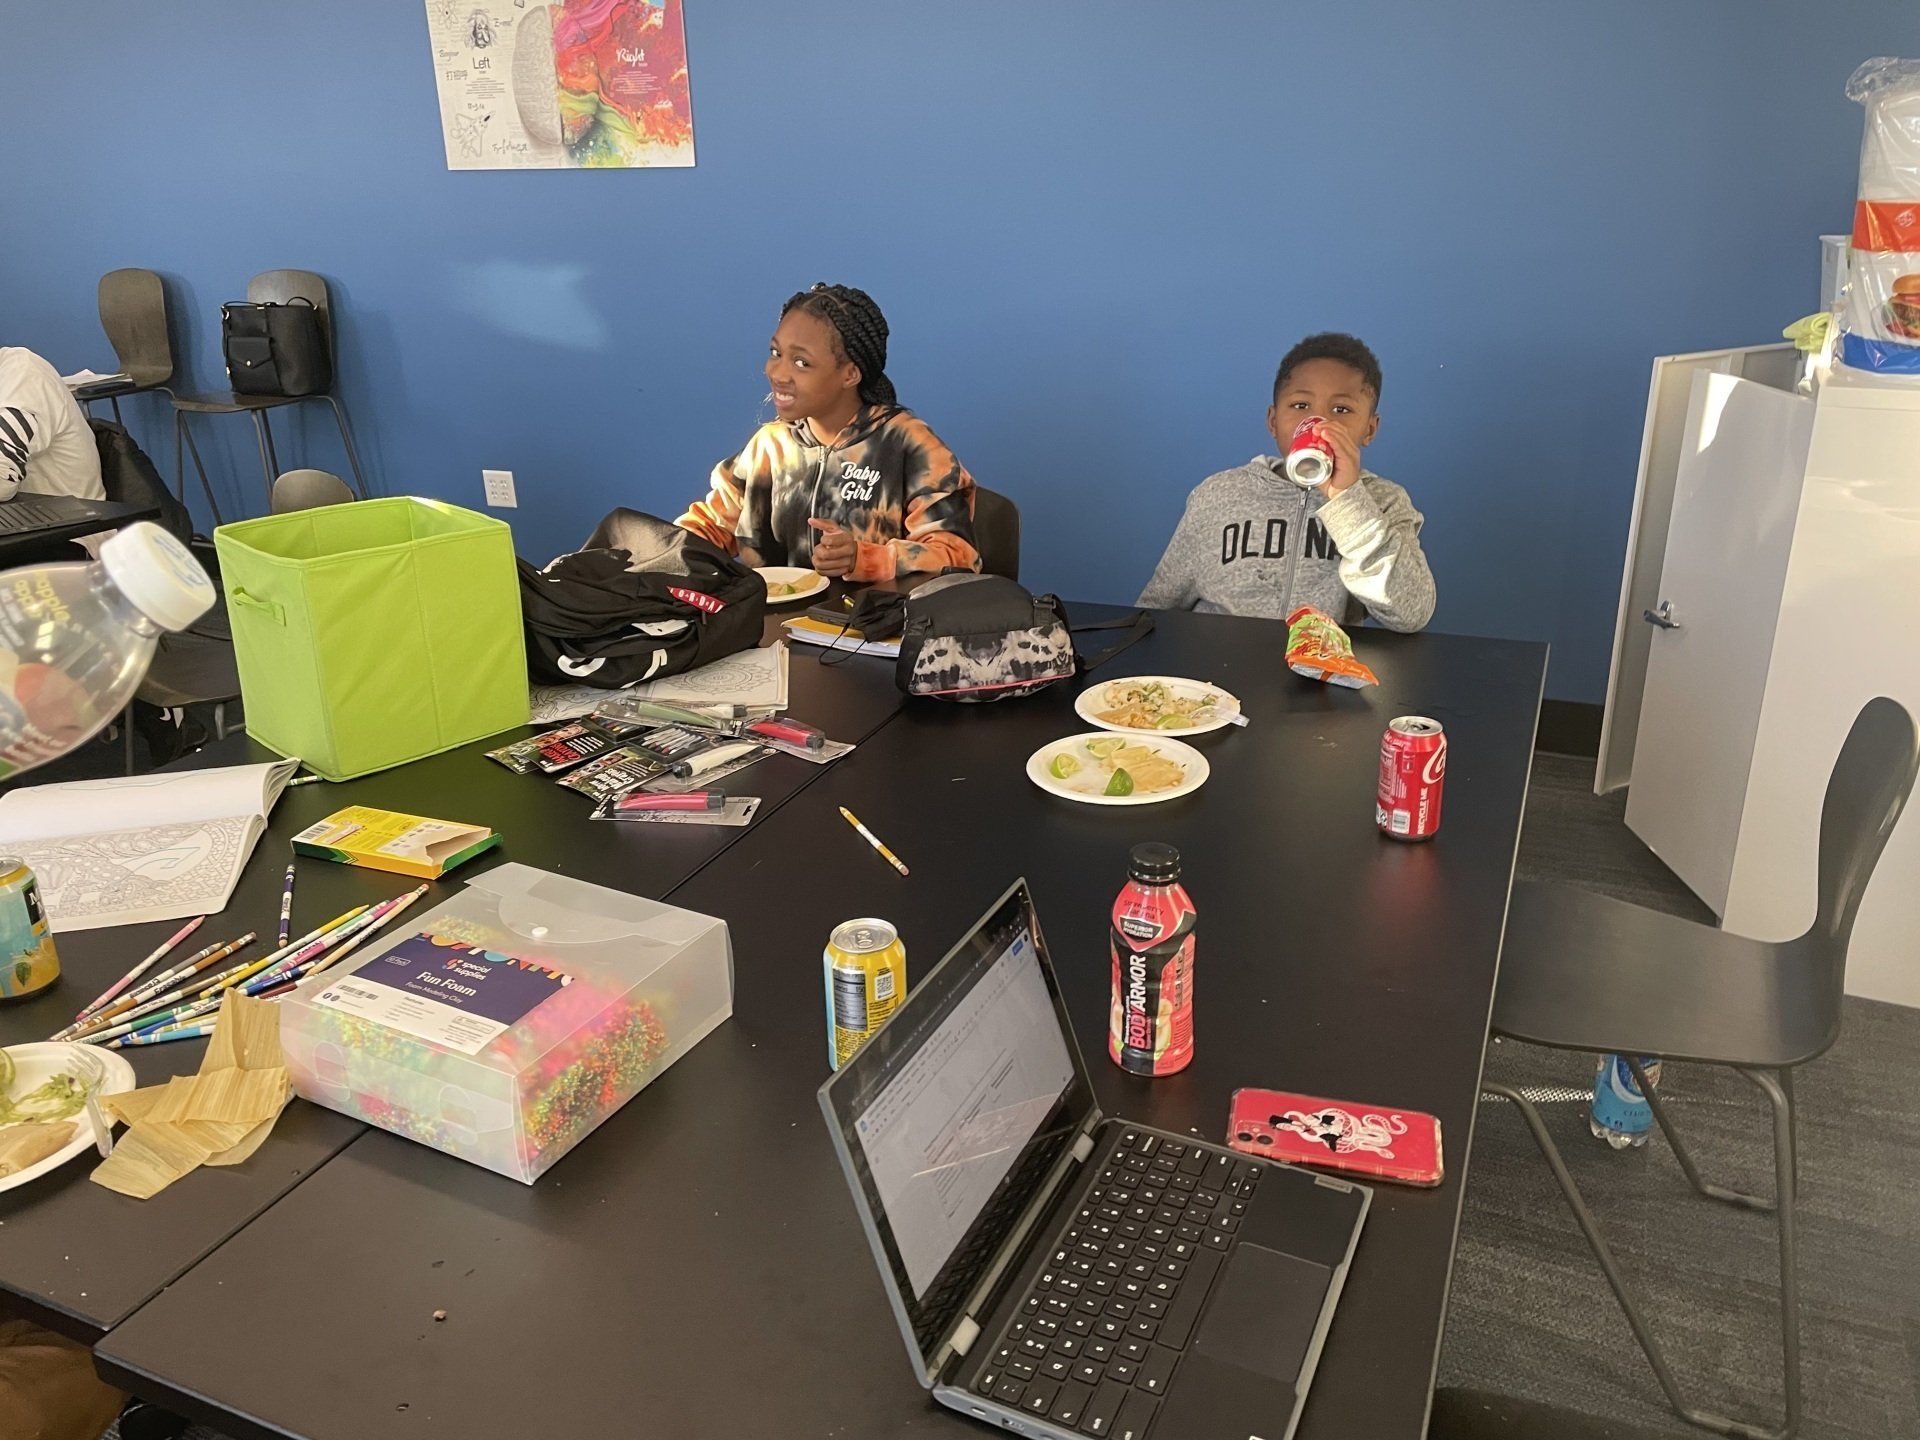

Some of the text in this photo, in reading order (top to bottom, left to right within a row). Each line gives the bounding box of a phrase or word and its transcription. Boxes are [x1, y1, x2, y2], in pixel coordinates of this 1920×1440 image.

[473, 57, 491, 69] Left
[616, 48, 645, 67] Right
[441, 461, 481, 486] Baby
[441, 481, 473, 501] Girl
[1222, 518, 1288, 565] OLD
[416, 971, 477, 996] Fun Foam
